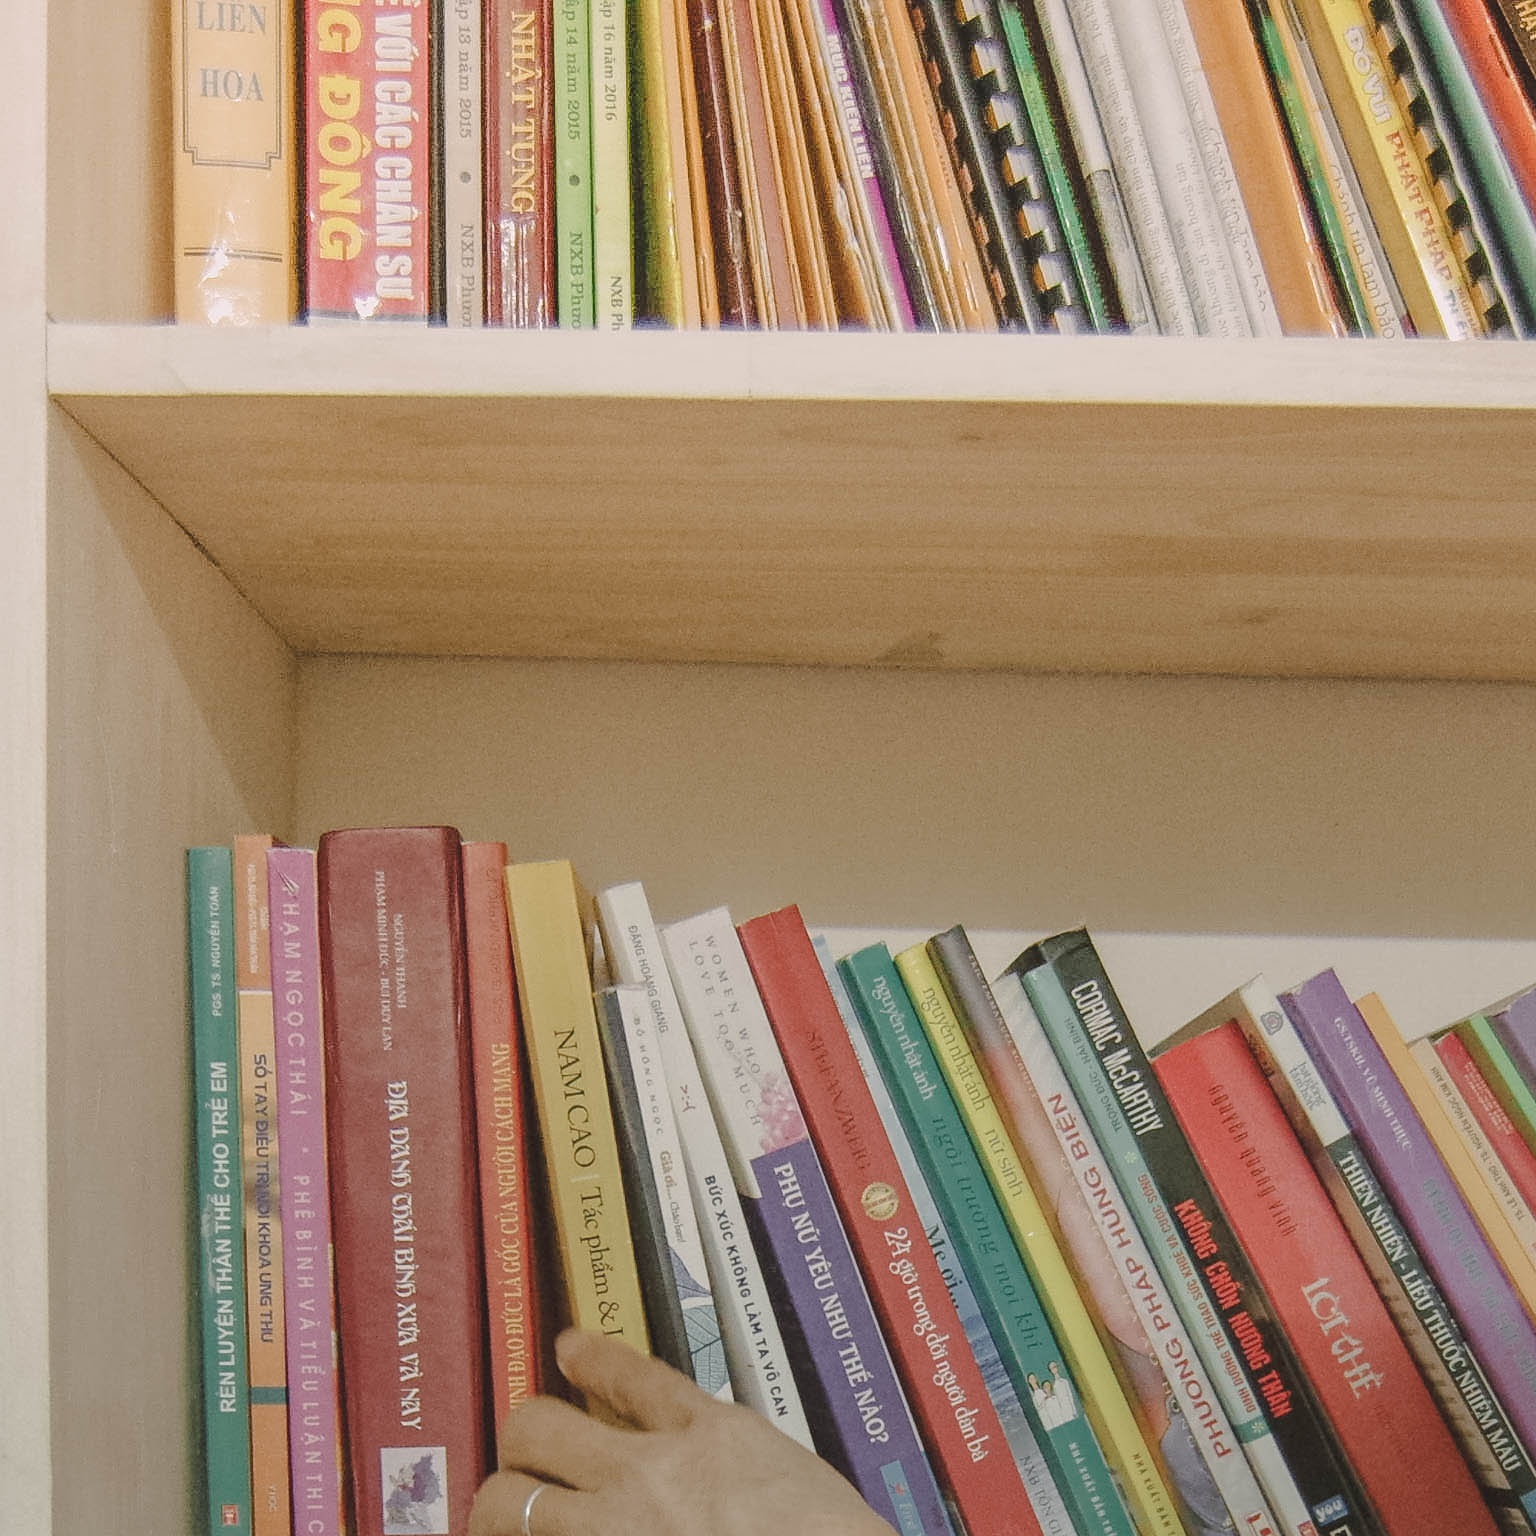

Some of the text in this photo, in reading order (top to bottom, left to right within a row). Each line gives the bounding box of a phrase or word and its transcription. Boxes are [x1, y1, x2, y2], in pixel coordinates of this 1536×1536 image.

[318, 75, 371, 259] ĐÔNG
[210, 1062, 228, 1091] EM
[553, 1028, 586, 1099] NAM
[1072, 980, 1162, 1135] CORMAC McCARTHY
[212, 1142, 230, 1187] CHO
[566, 1104, 596, 1168] CAO
[907, 1285, 937, 1336] trong
[755, 1339, 770, 1357] TA
[769, 1385, 788, 1417] CAN
